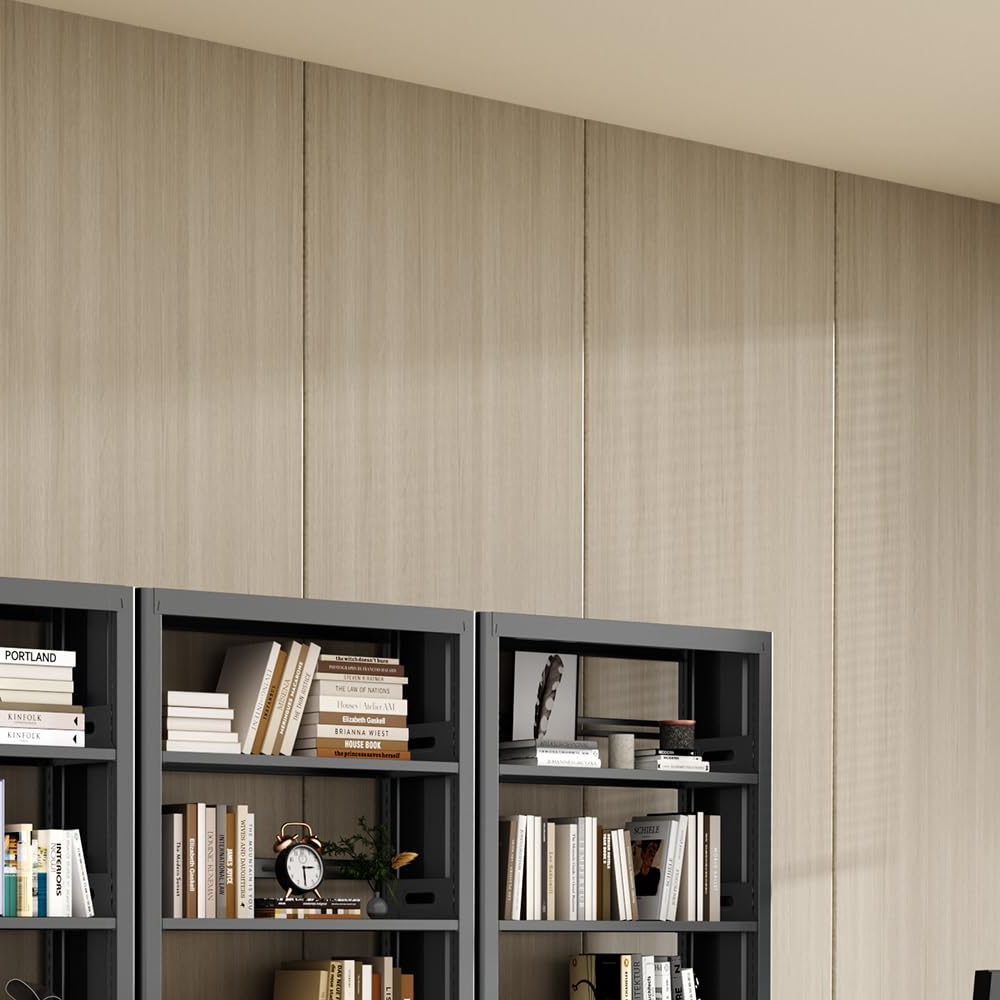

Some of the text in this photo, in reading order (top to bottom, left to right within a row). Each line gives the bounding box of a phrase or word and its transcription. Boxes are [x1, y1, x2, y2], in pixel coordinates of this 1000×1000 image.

[4, 650, 57, 662] PORTLAND
[8, 713, 42, 722] KINFOLK
[8, 732, 41, 740] KINFOLK
[344, 740, 382, 750] HOUSE BOOK
